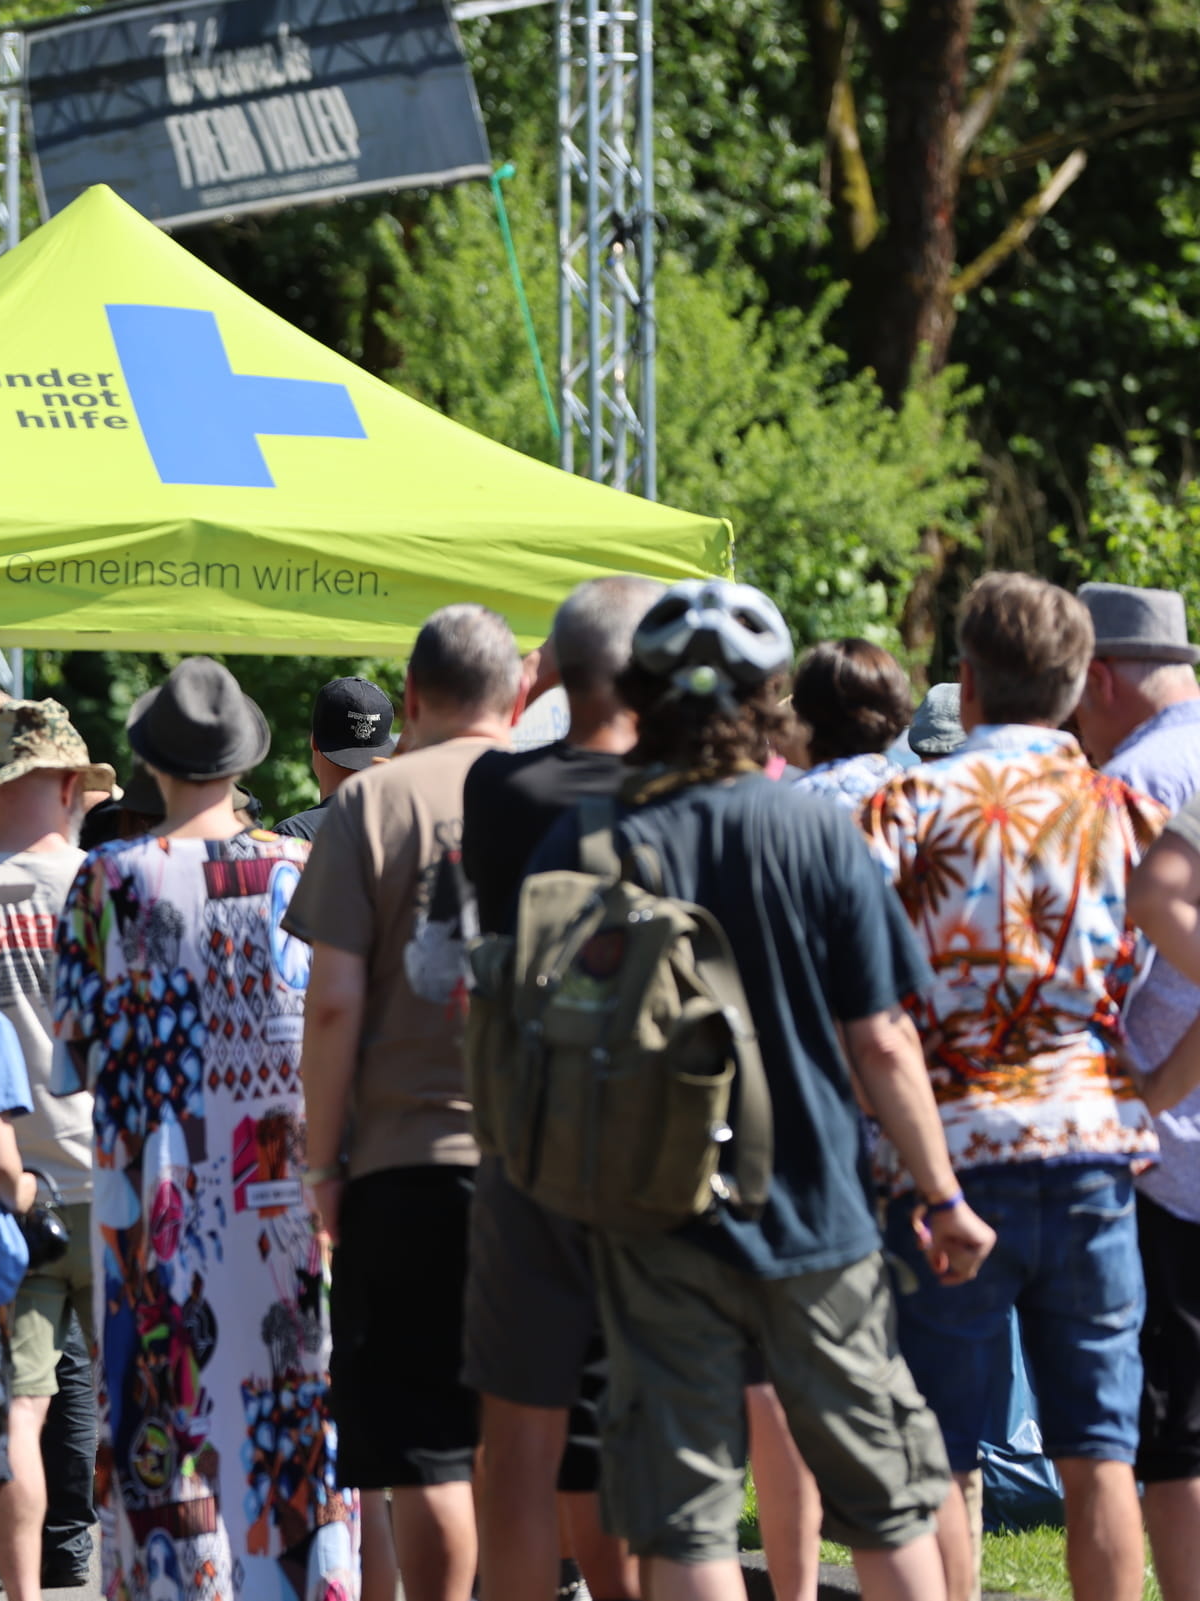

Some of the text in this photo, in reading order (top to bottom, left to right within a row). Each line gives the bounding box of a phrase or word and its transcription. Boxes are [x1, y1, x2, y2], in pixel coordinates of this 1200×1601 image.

[247, 84, 361, 173] VALLEY
[42, 389, 121, 408] not
[15, 410, 129, 429] hilfe
[5, 552, 241, 589] Gemeinsam
[253, 558, 389, 597] wirken.
